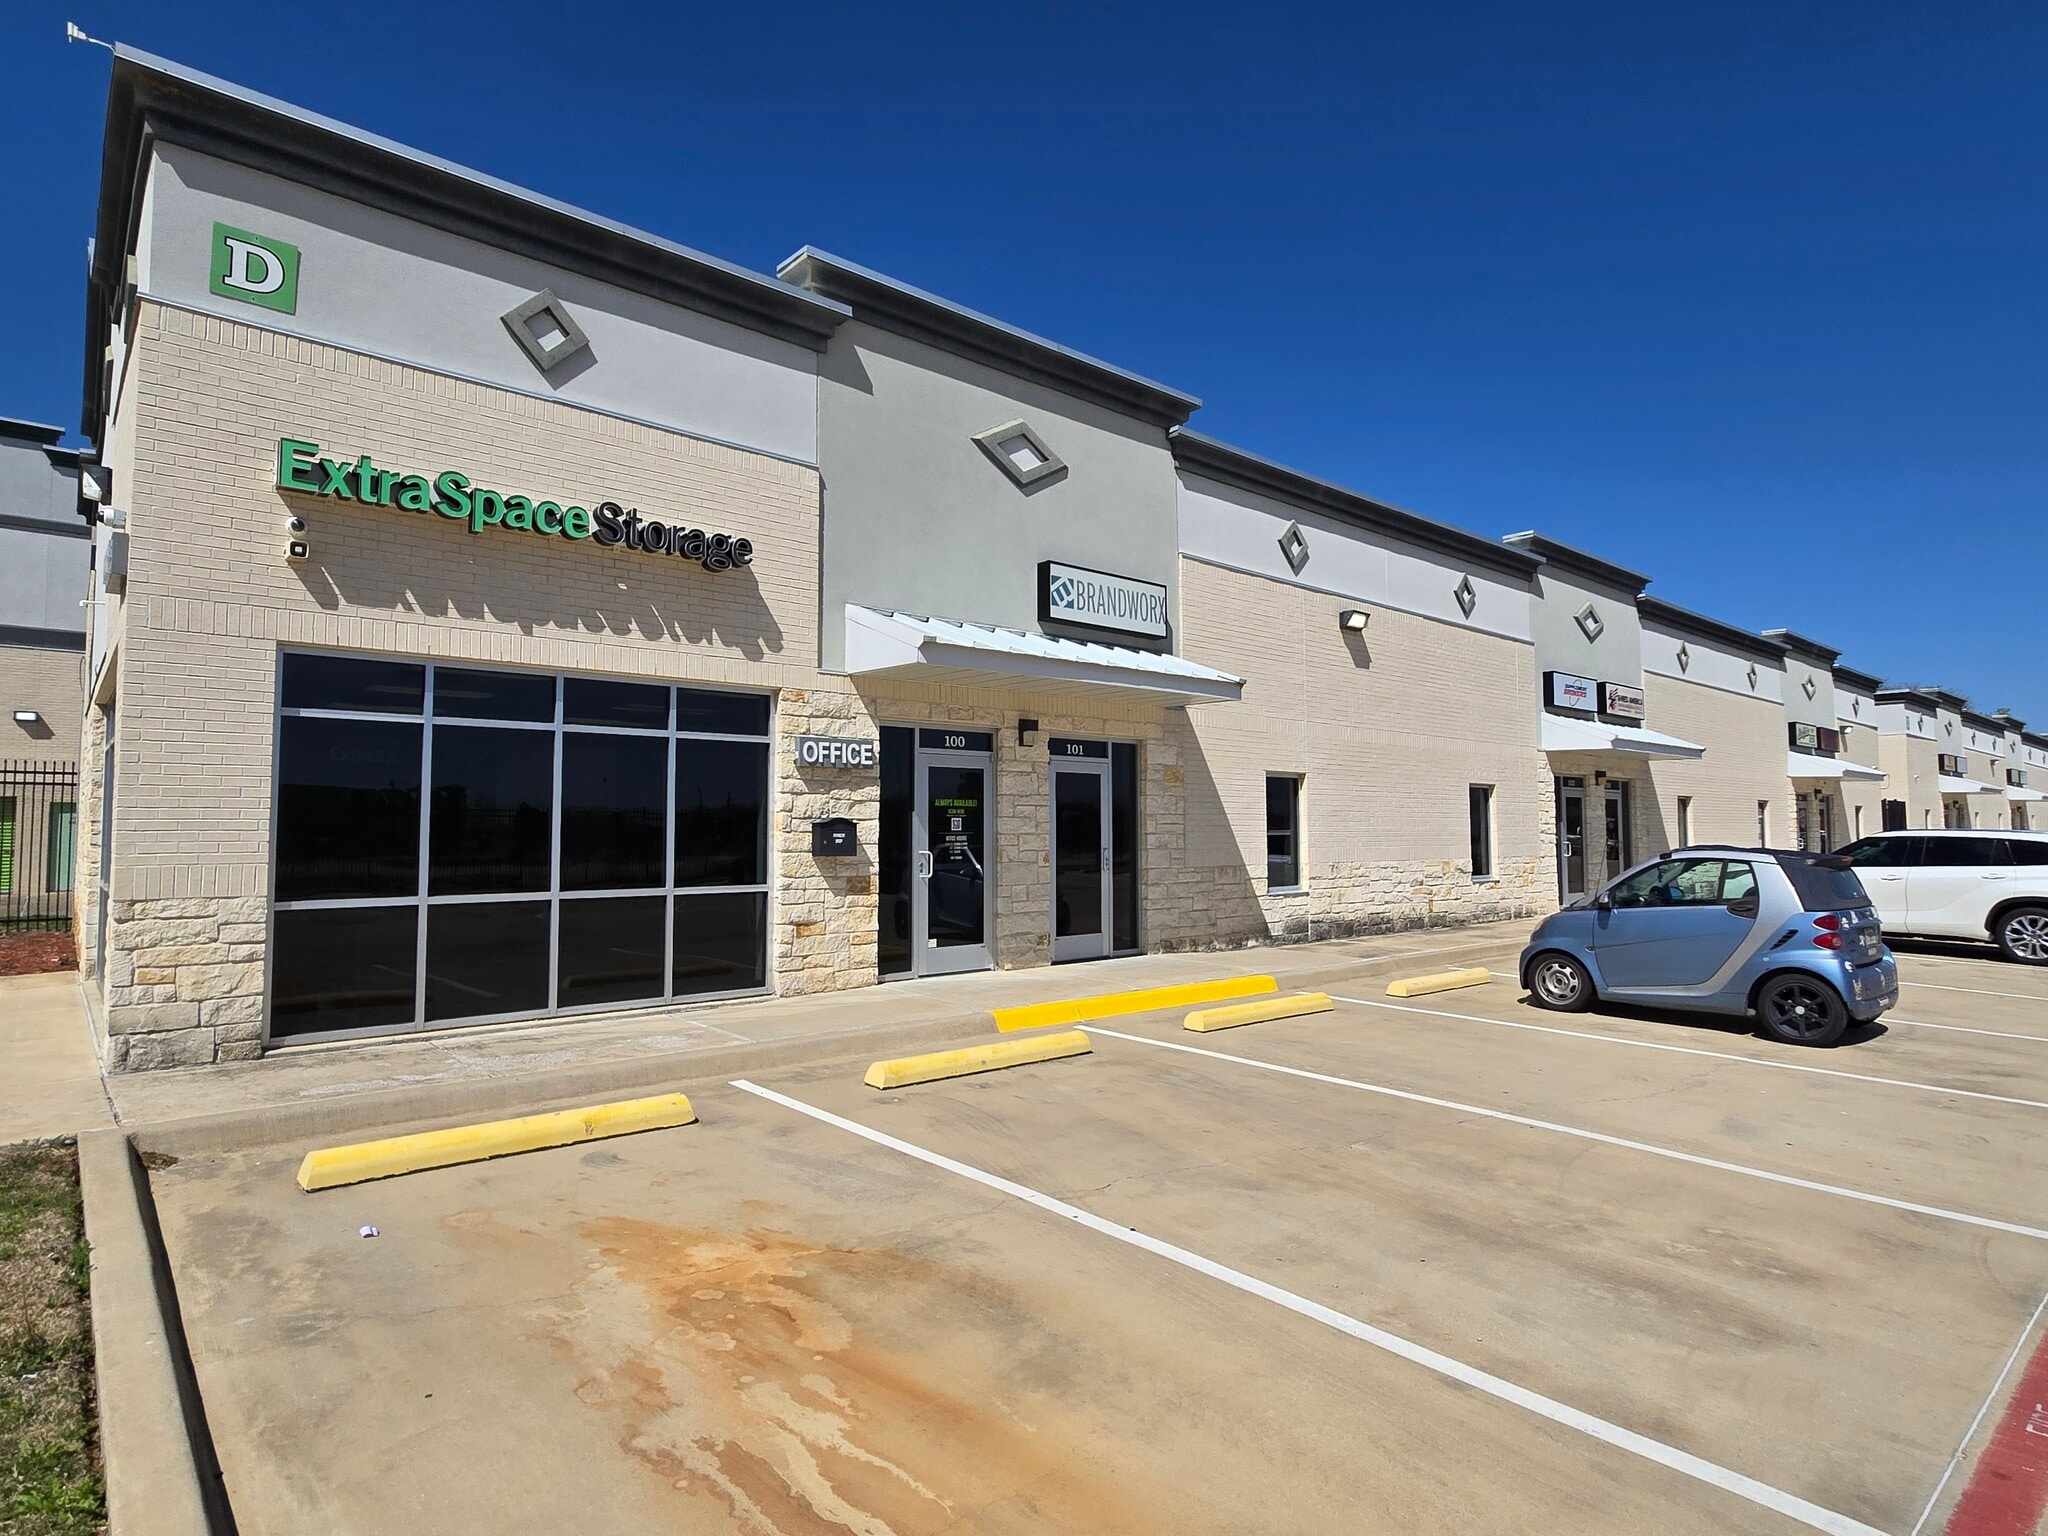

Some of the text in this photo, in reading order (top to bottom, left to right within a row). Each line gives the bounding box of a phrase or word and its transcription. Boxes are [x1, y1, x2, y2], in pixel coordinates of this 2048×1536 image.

[222, 236, 286, 294] D
[1076, 579, 1166, 625] BRANDWORX
[802, 740, 873, 766] OFFICE
[944, 735, 966, 748] 100
[1066, 743, 1084, 756] 101
